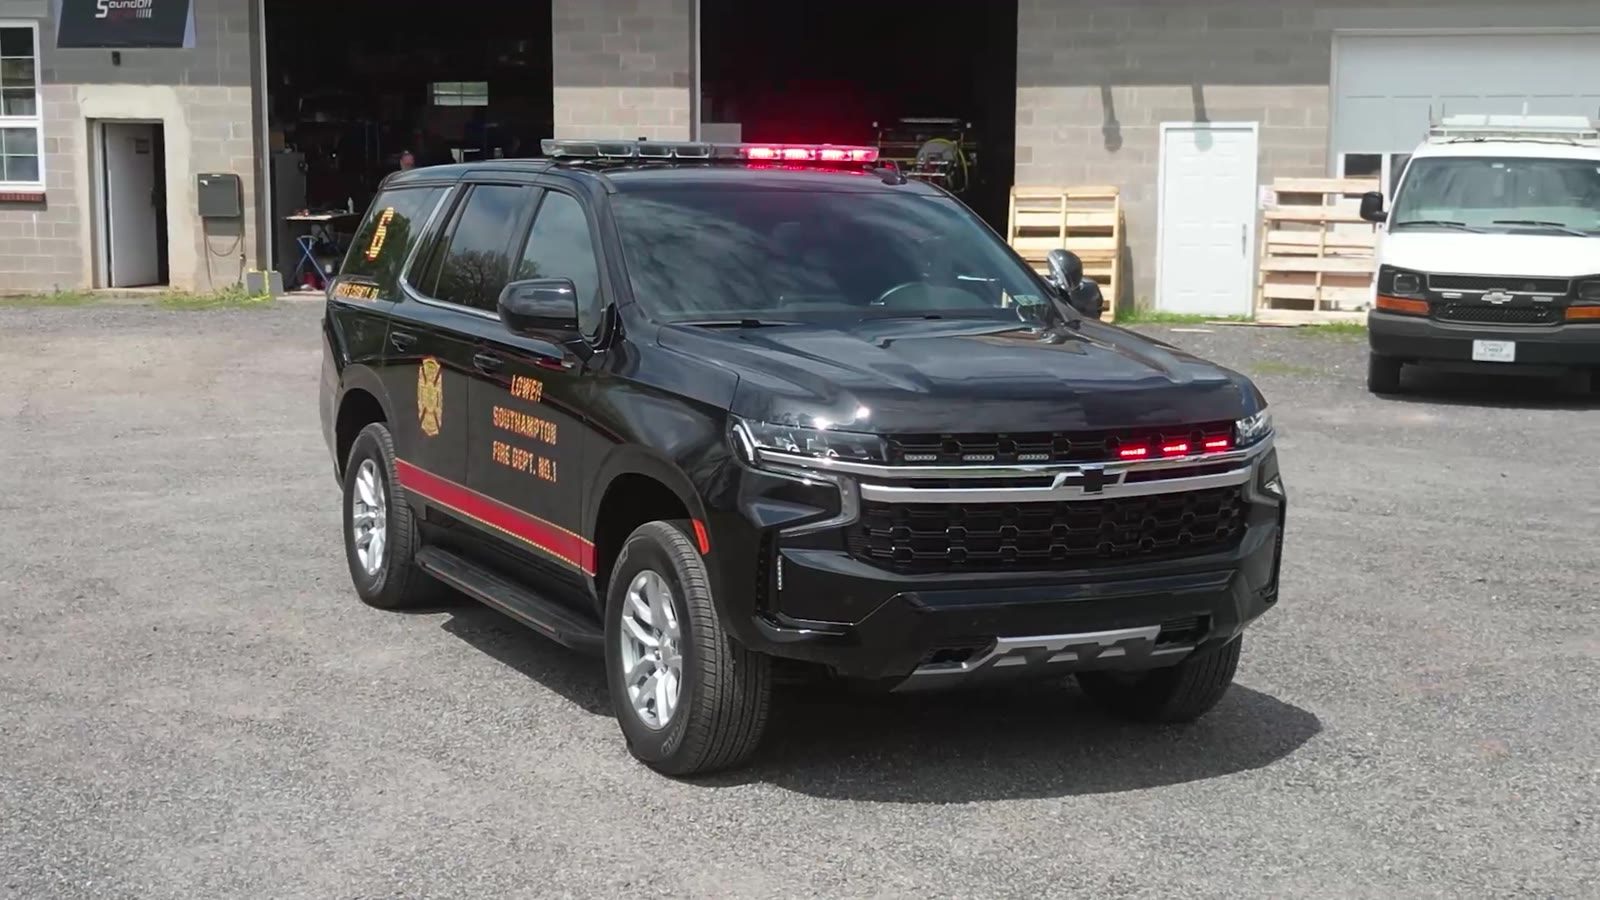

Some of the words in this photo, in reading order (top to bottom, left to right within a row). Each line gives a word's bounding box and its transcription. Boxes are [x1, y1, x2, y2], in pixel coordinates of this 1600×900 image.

[511, 374, 543, 402] LOWER
[493, 405, 557, 446] SOUTHAMPTON
[492, 440, 511, 466] FIRE
[512, 447, 537, 474] DEPT.
